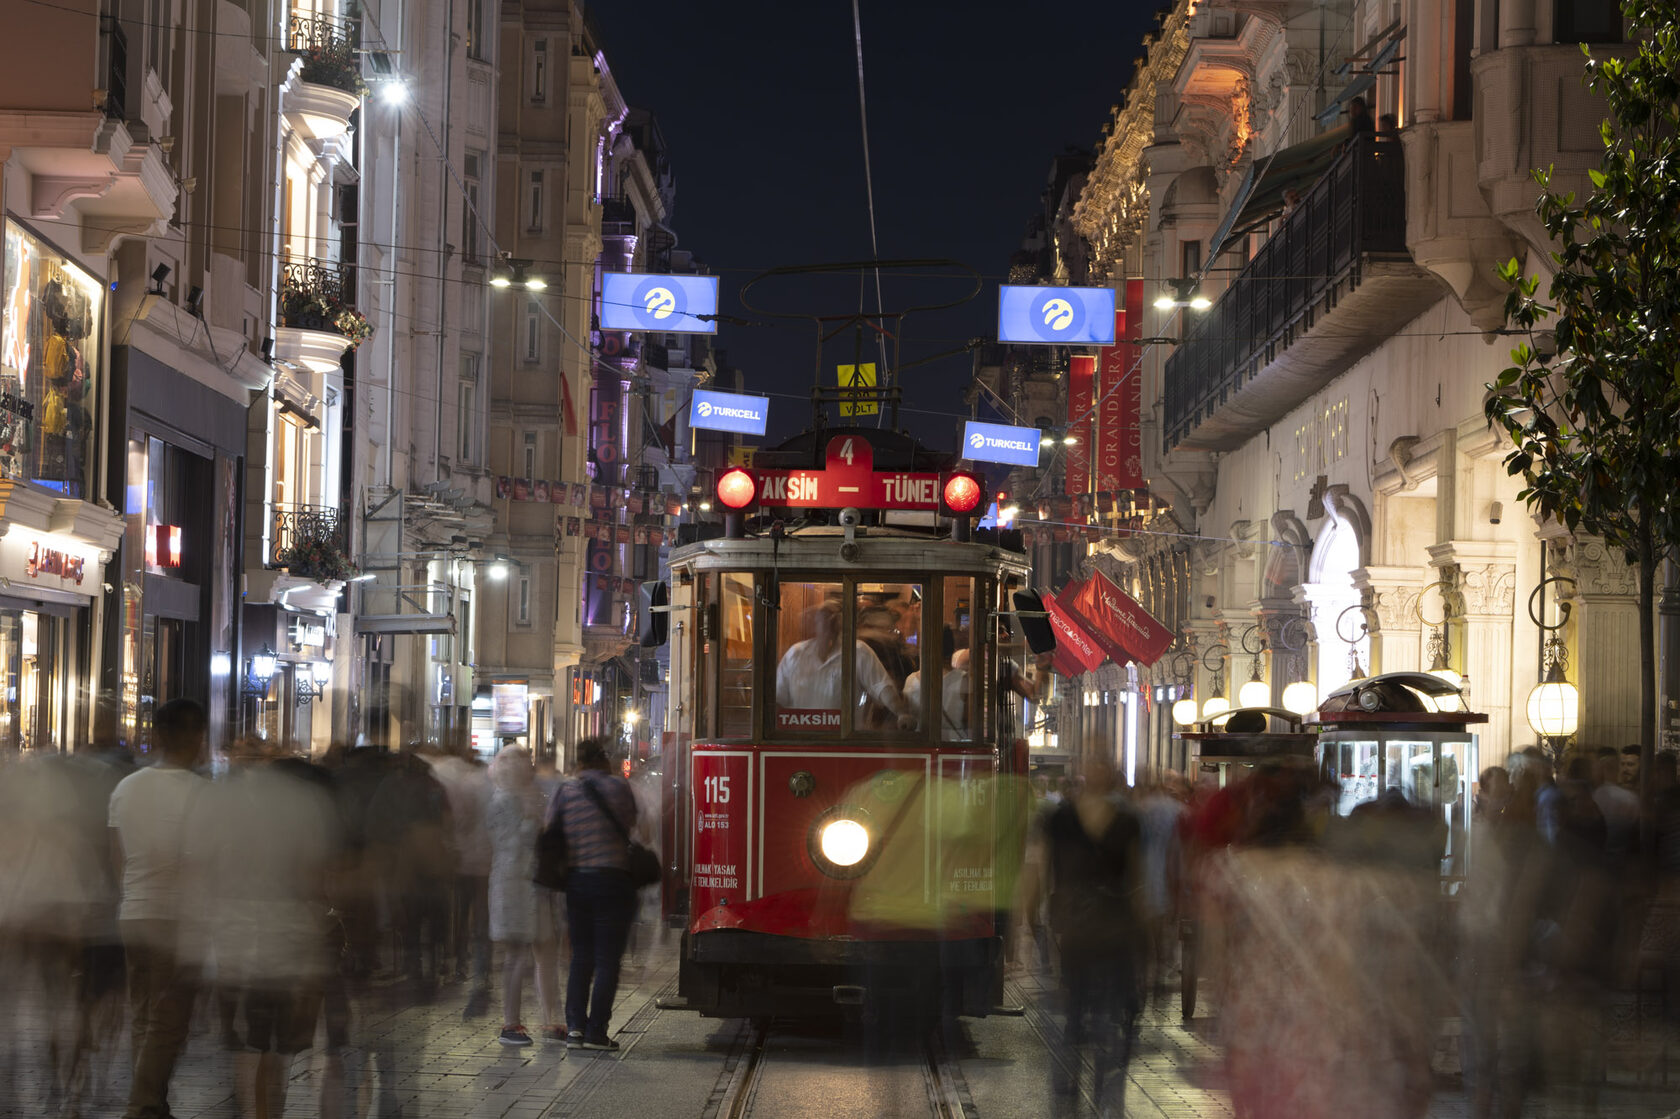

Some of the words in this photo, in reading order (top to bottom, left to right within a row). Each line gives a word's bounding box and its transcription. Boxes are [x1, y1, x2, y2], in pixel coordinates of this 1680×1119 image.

[713, 406, 761, 421] TURKCELL
[986, 437, 1033, 452] TURKCELL
[840, 439, 854, 466] 4
[760, 472, 818, 501] AKSİM
[779, 711, 841, 726] TAKSİM
[704, 775, 731, 804] 115
[717, 821, 729, 829] 153
[714, 864, 736, 876] YASAK
